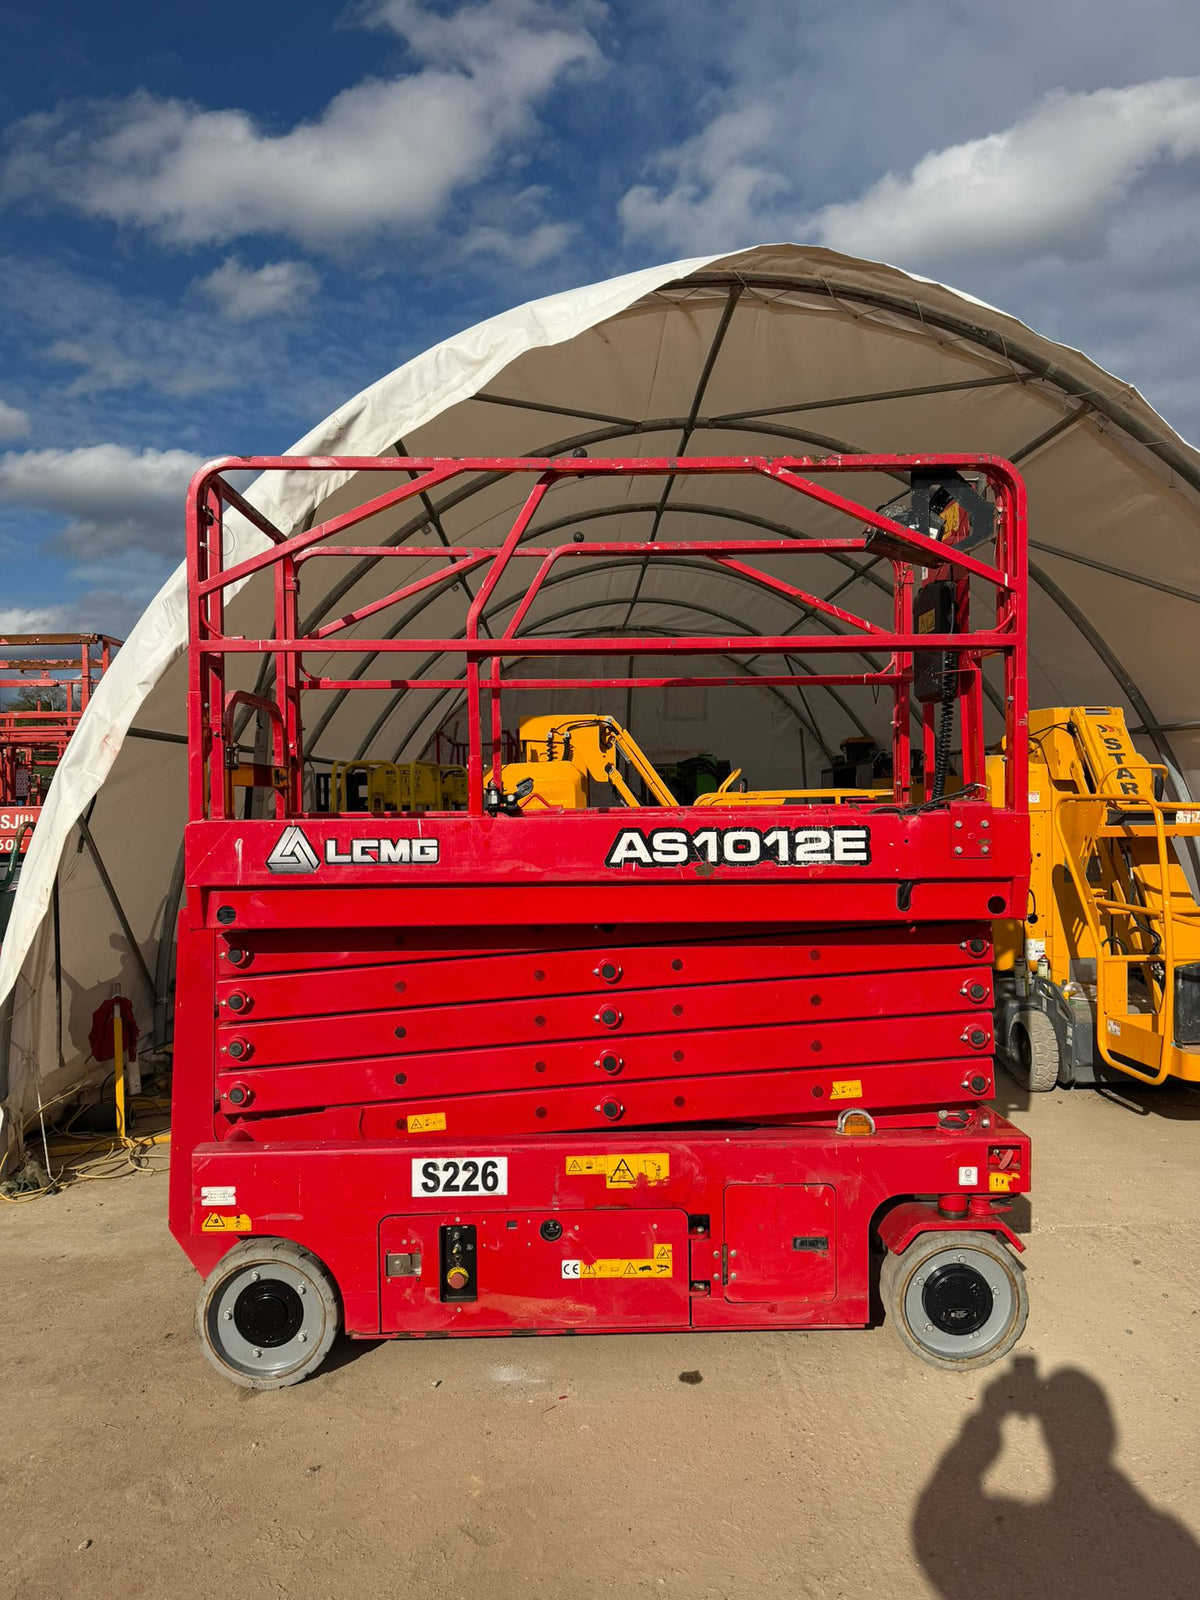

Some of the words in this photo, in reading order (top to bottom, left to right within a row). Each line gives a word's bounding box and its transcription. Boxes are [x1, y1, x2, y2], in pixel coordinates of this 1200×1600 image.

[1103, 738, 1139, 795] STAR
[325, 838, 439, 864] LGMG
[608, 828, 869, 864] AS1012E
[421, 1160, 499, 1193] S226
[563, 1263, 579, 1275] CE
